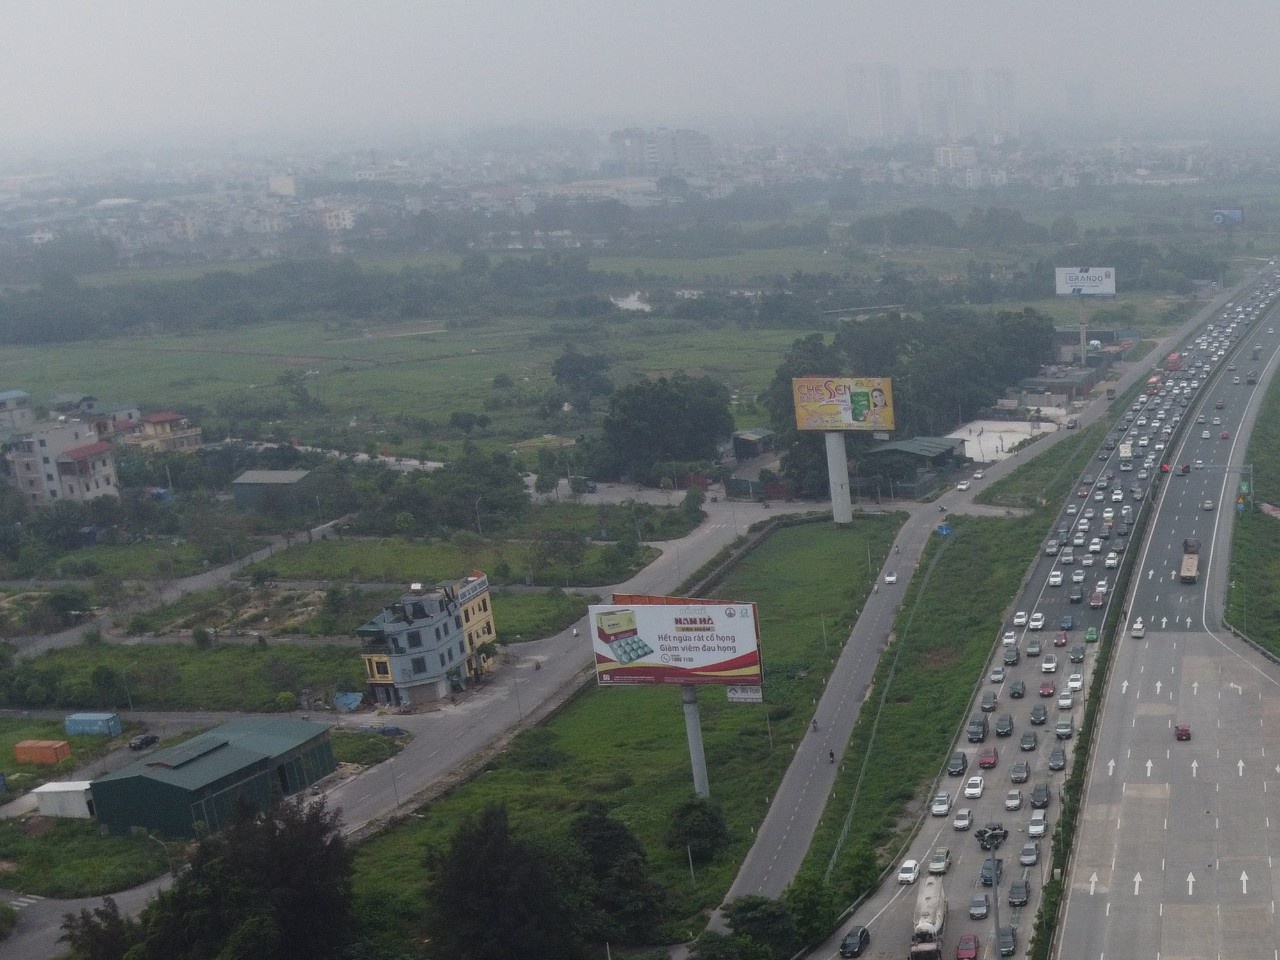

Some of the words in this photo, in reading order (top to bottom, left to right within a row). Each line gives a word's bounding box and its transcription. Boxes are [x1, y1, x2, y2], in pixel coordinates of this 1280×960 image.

[657, 634, 673, 642] Hết
[716, 635, 736, 643] họng
[717, 645, 737, 653] họng
